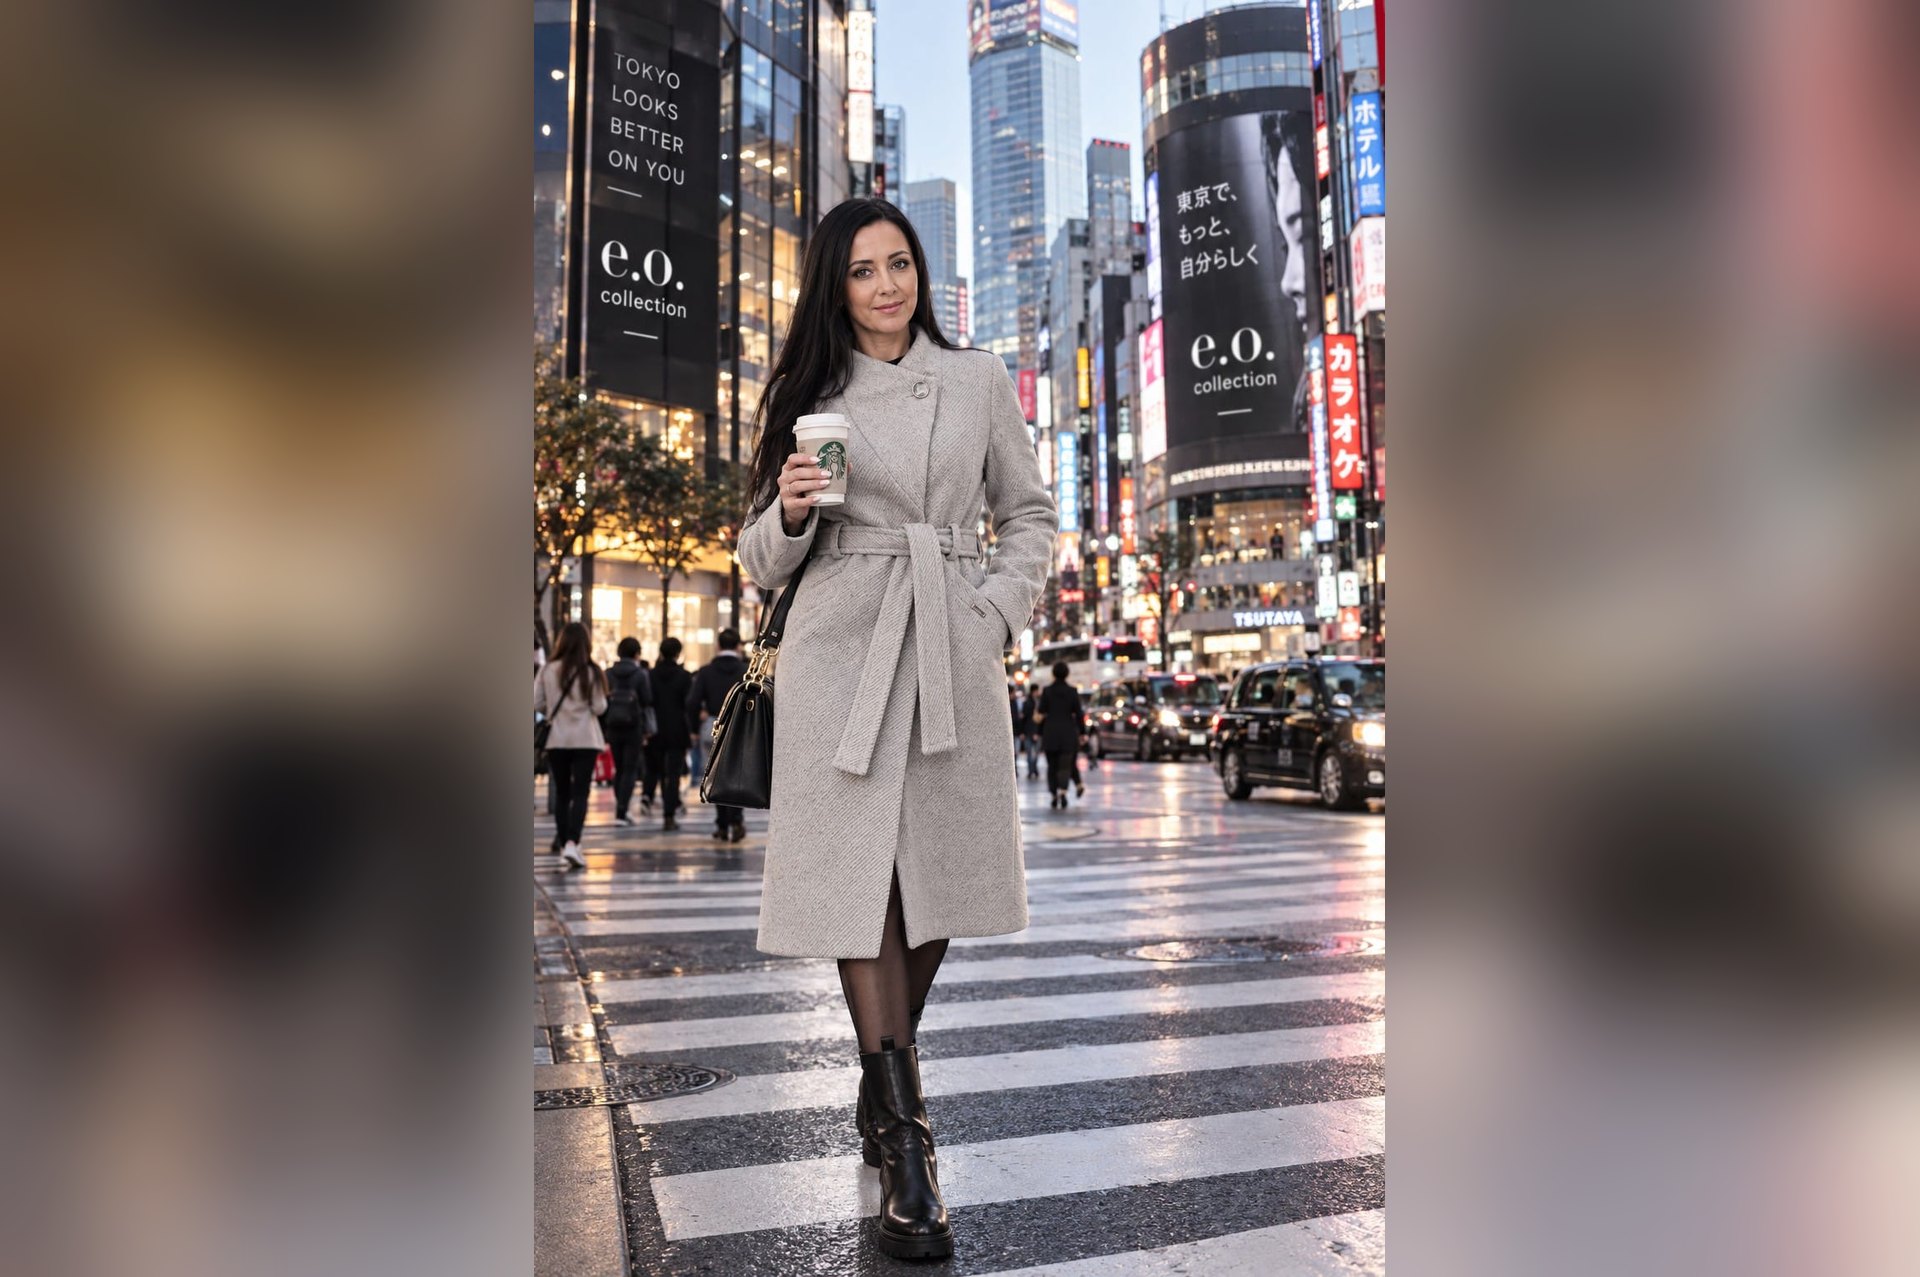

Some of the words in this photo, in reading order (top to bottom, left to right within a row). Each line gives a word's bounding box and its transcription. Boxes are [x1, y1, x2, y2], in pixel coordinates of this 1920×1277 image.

[614, 53, 680, 89] TOKYO
[612, 85, 678, 120] LOOKS
[611, 117, 684, 154] BETTER
[608, 150, 638, 173] ON
[646, 160, 685, 186] YOU
[1177, 182, 1238, 215] 東京で、
[1179, 216, 1231, 245] もっと、
[601, 240, 685, 291] e.o.
[1180, 243, 1260, 279] 自分らしく
[601, 289, 687, 318] collection
[1191, 327, 1276, 369] e.o.
[1194, 371, 1278, 395] collection
[1329, 343, 1359, 479] カラオケ
[1233, 610, 1305, 628] TSUTAYA
